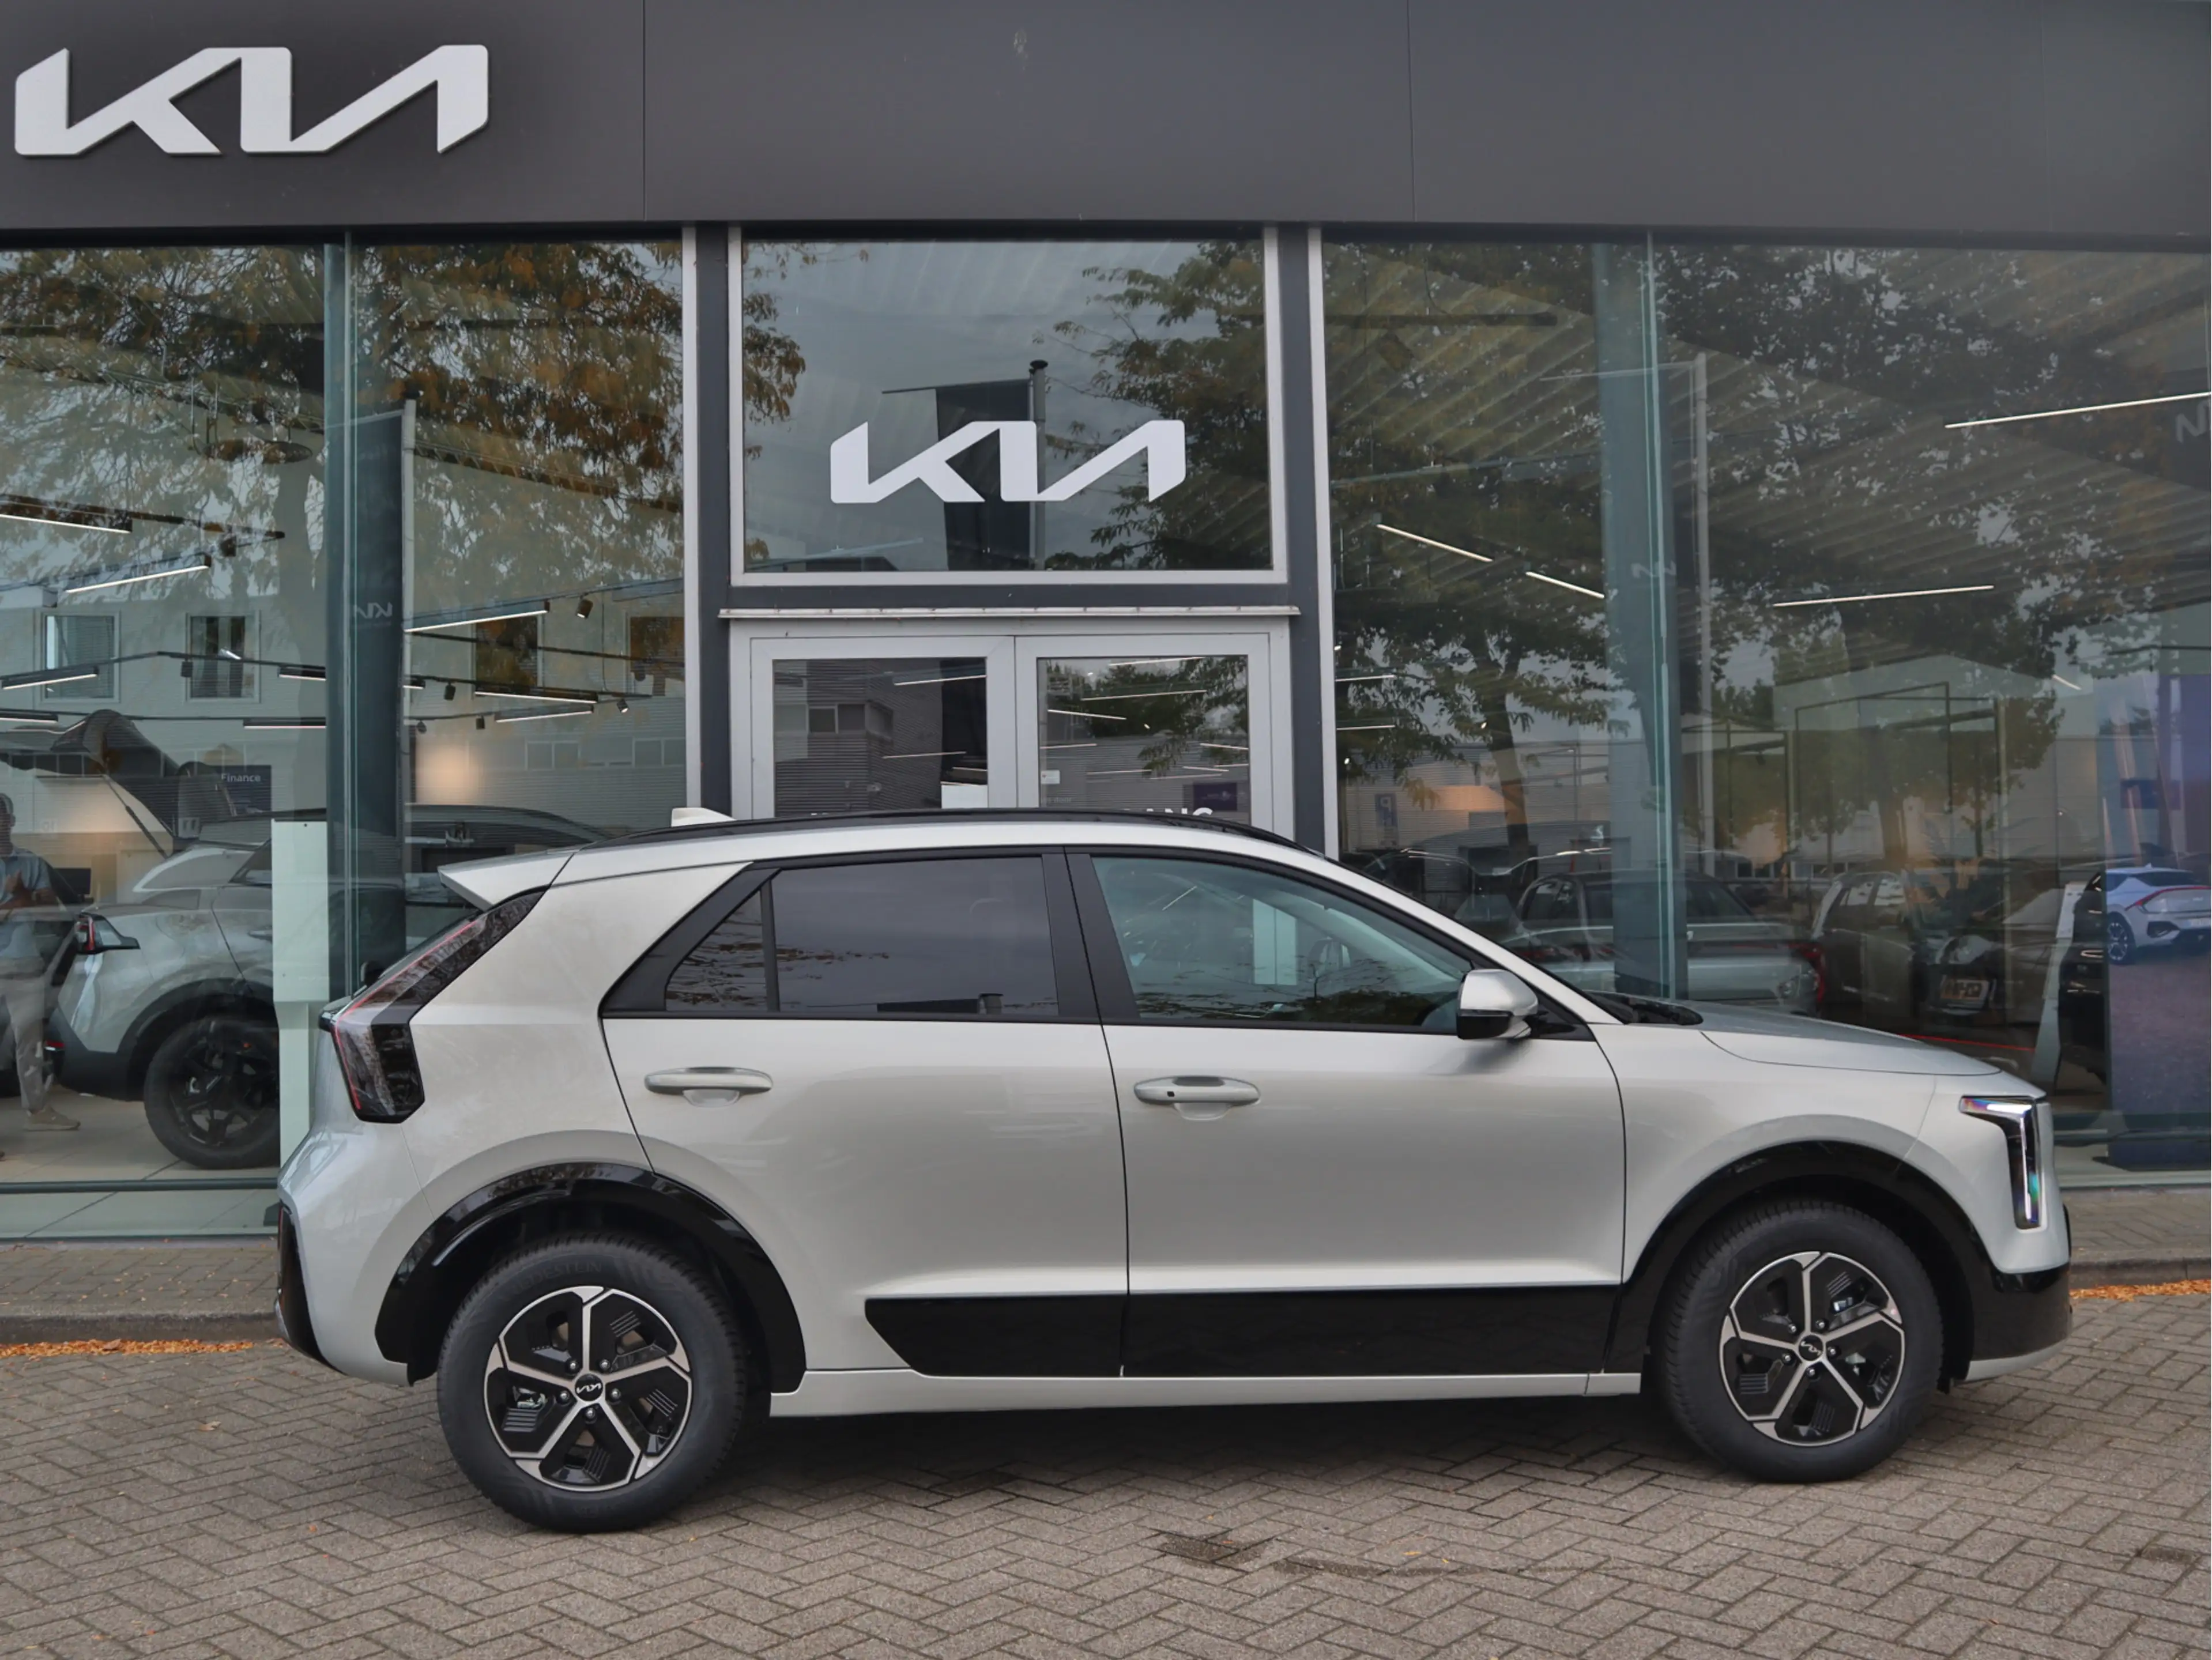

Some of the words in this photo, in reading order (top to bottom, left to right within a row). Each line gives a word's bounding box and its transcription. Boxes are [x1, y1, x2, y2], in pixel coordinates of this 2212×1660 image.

[15, 45, 489, 156] KIA
[830, 420, 1185, 504] KIA
[221, 772, 261, 782] Finance
